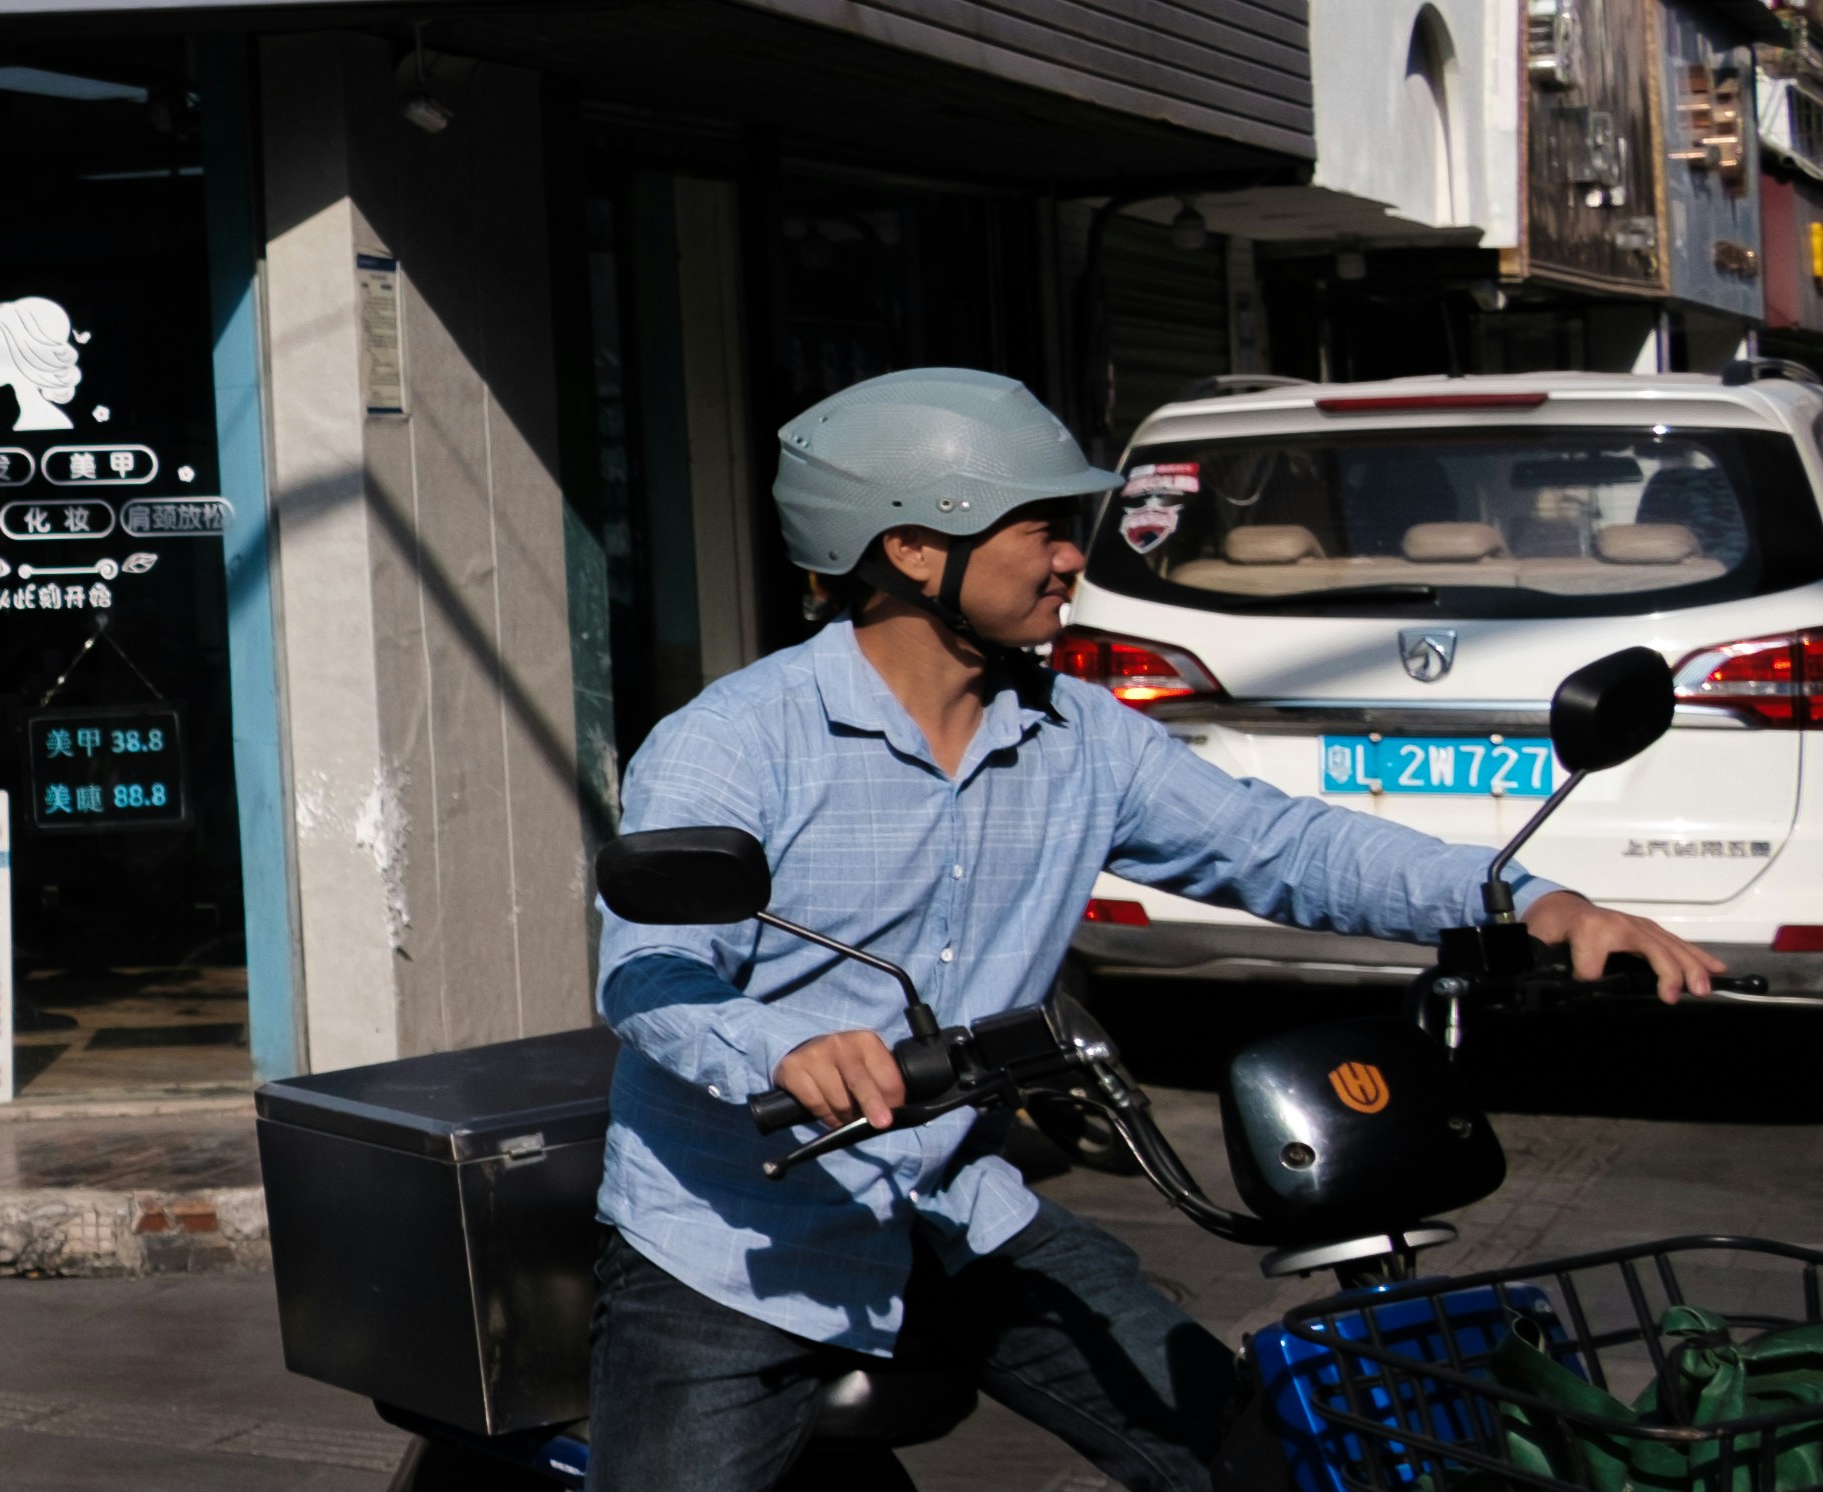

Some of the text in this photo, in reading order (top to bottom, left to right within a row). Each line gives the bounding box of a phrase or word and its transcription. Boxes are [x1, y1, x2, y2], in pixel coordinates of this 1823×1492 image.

[69, 449, 135, 482] 美甲
[23, 505, 91, 534] 化妆
[45, 727, 165, 759] 美甲 38.8
[44, 782, 167, 815] 美睫 88.8
